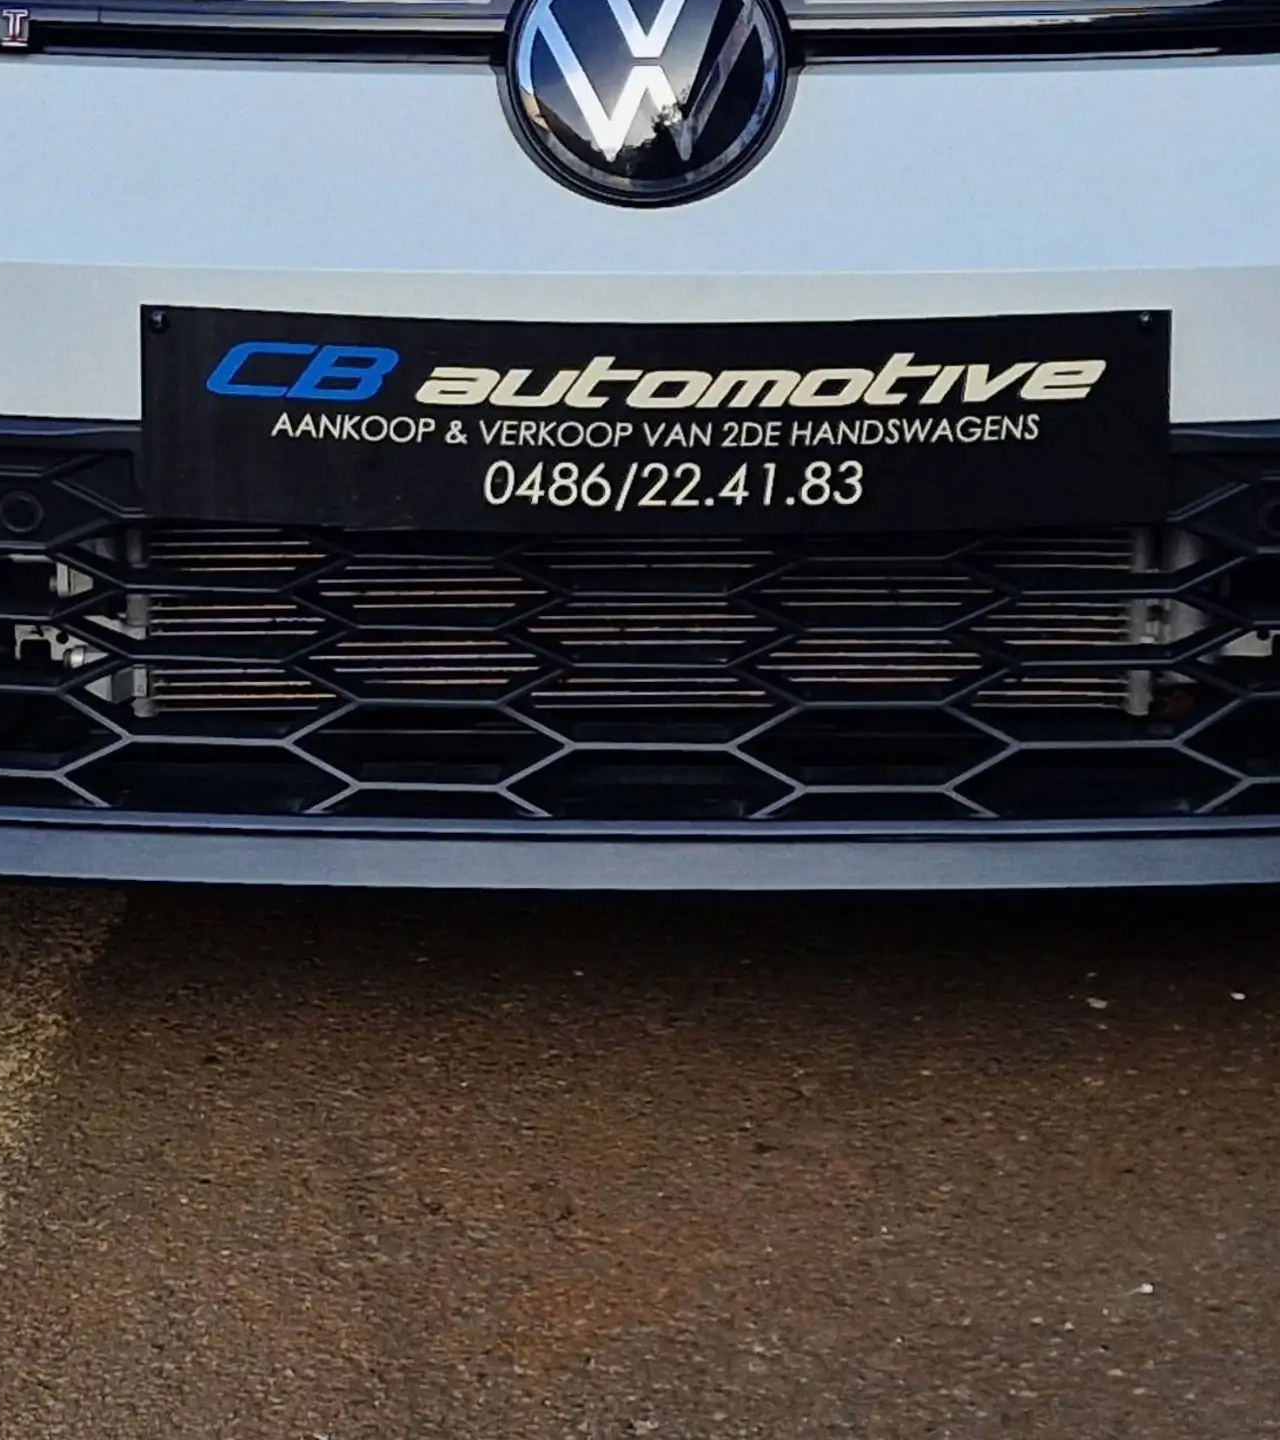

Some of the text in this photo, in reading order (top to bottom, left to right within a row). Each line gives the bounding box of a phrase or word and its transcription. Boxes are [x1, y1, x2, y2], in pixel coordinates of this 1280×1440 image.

[206, 341, 1107, 409] CB automotive
[271, 412, 1040, 448] AANKOOP & VERKOOP VAN 2DE HANDSWAGENS
[484, 460, 863, 512] 0486/22.41.83
